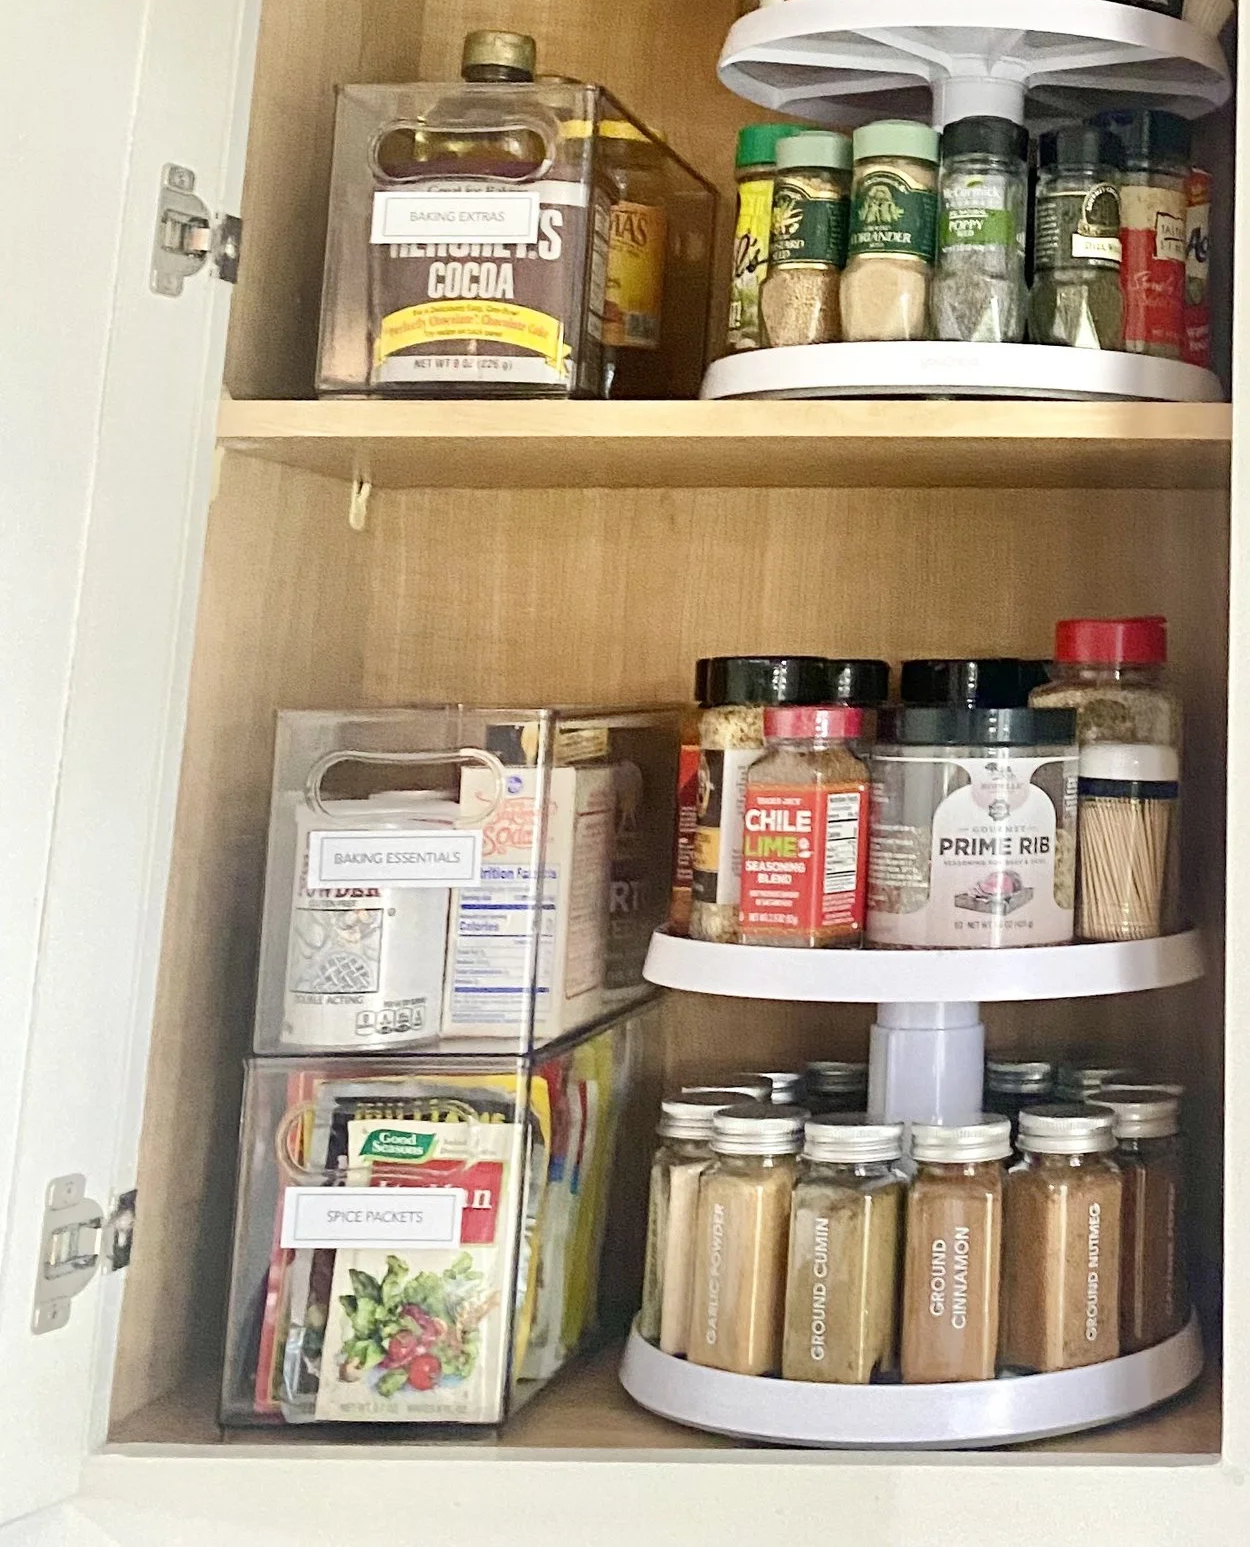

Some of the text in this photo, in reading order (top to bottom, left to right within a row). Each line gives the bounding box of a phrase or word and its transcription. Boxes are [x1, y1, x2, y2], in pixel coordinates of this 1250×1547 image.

[410, 211, 505, 222] BAKING EXTRAS
[949, 219, 984, 232] POPPY
[427, 261, 515, 300] COCOA
[745, 809, 812, 832] CHILE
[744, 835, 798, 858] LIME
[939, 836, 1050, 856] PRIME RIB
[334, 851, 460, 865] BAKING ESSENTIALS
[481, 865, 514, 880] trition
[745, 860, 806, 873] SEASONING
[757, 872, 792, 885] BLEND
[460, 920, 499, 932] Calories
[326, 995, 364, 1005] ACTING
[379, 1132, 417, 1146] Good
[371, 1140, 424, 1155] Seasons
[327, 1211, 423, 1223] SPICE PACKETS
[705, 1203, 725, 1345] GARLIC POWDER
[929, 1238, 946, 1317] GROUND
[951, 1226, 970, 1330] CINNAMON
[1086, 1202, 1101, 1341] GROUND NUTMEG
[810, 1217, 829, 1361] GROUND CUMIN
